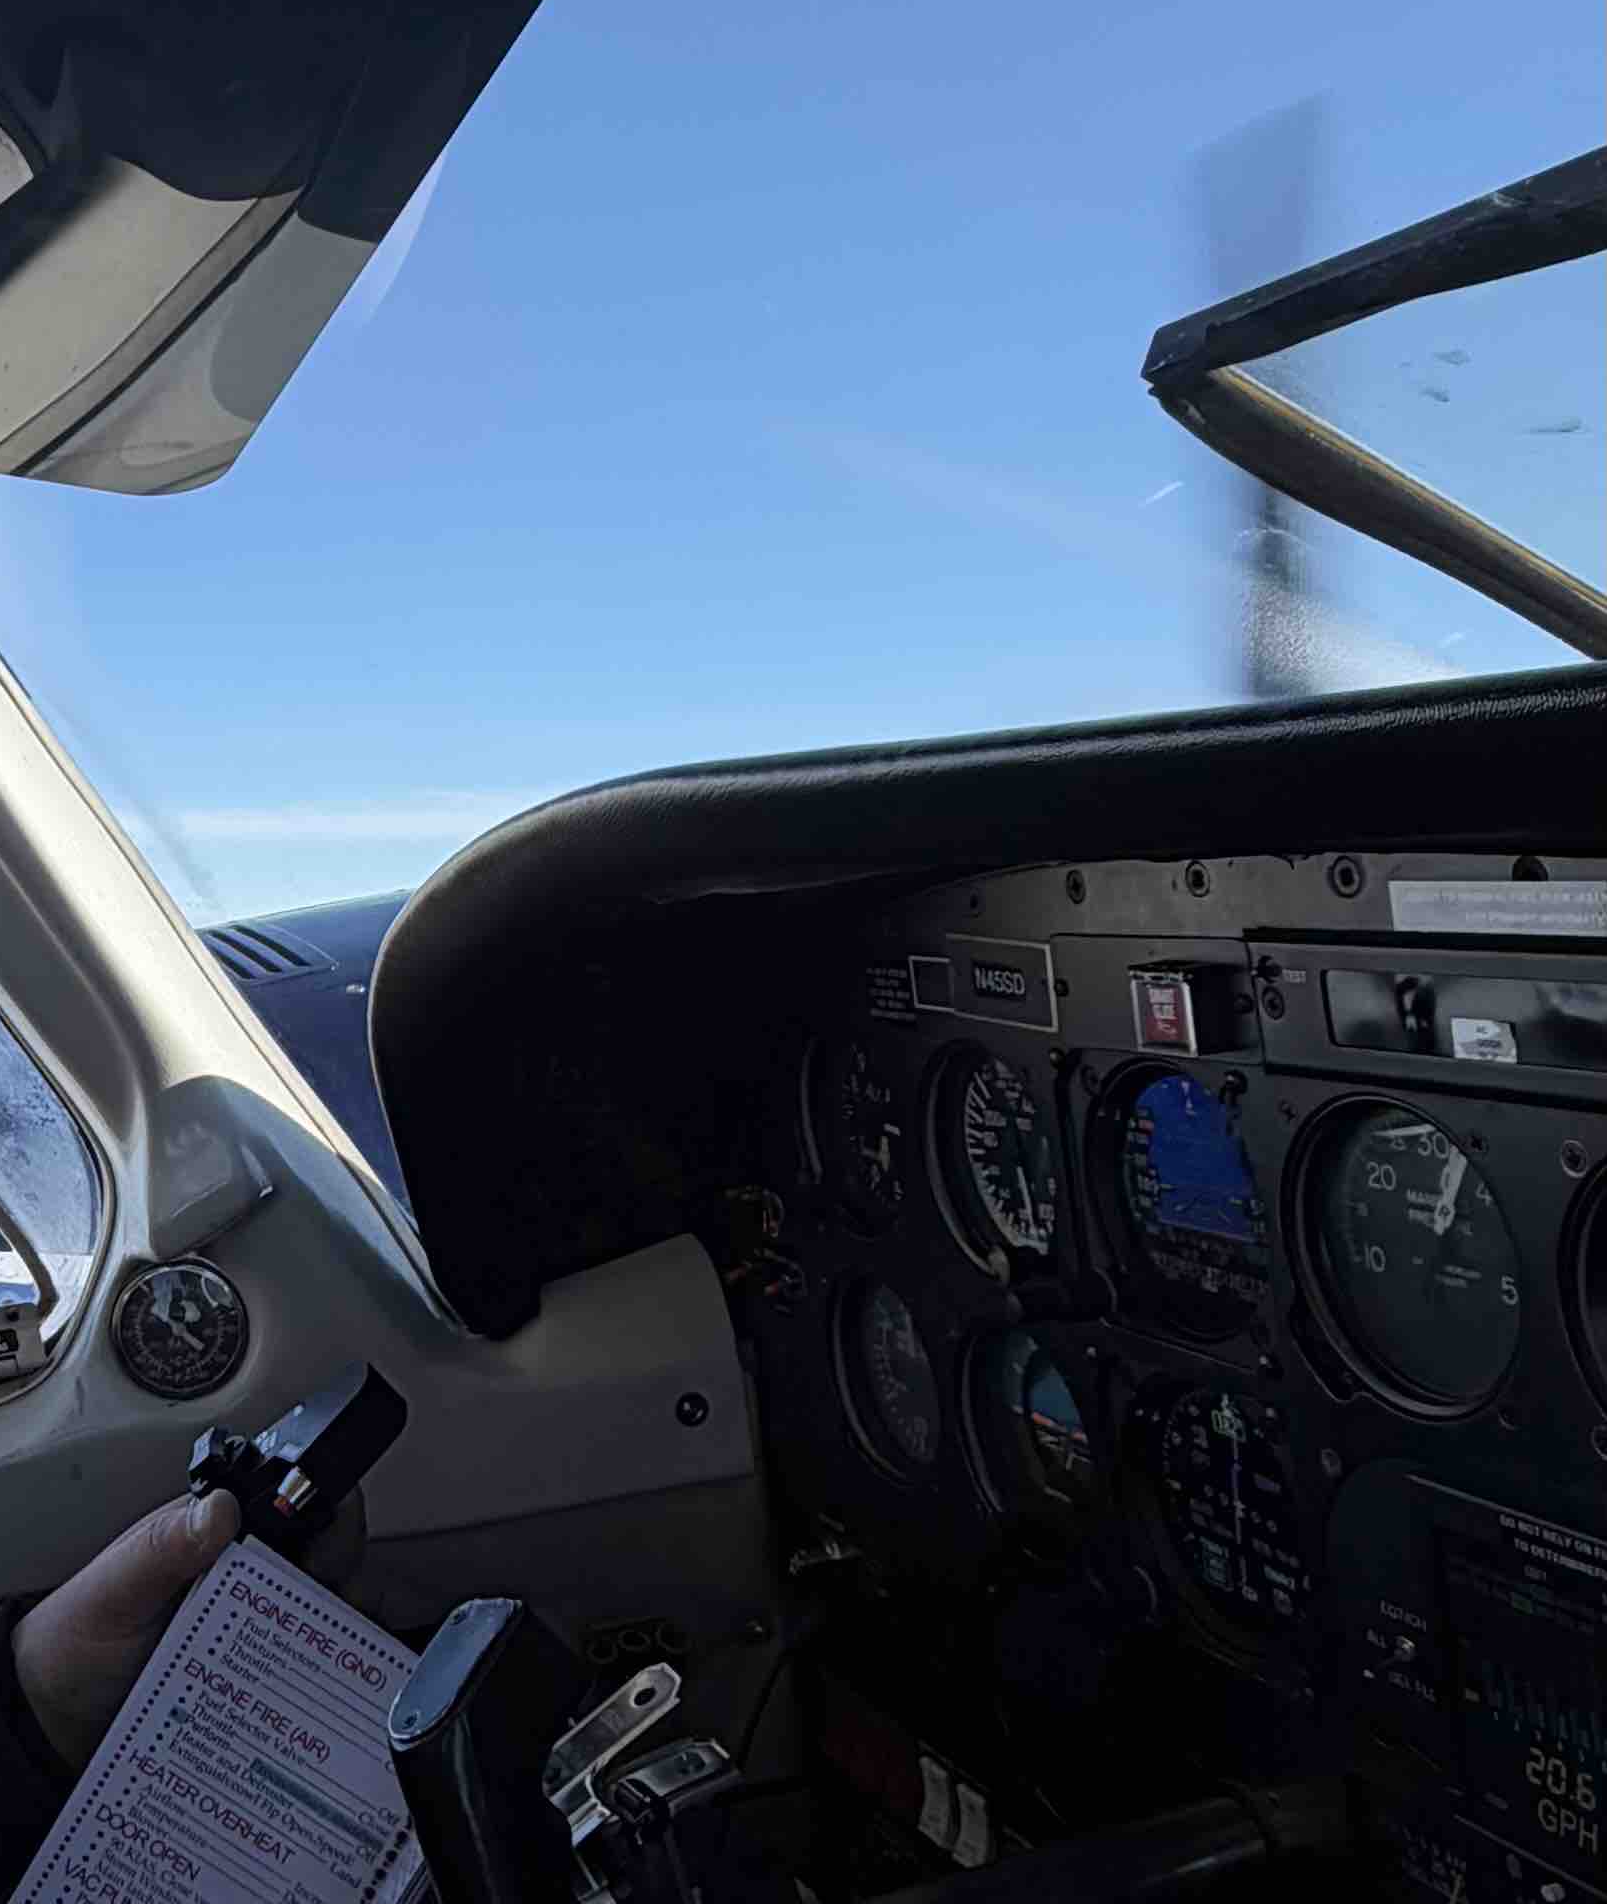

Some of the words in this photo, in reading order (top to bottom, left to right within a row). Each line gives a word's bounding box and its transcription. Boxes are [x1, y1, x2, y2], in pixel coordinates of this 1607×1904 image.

[1417, 1132, 1450, 1159] 30
[1367, 1162, 1396, 1191] 20
[1475, 1181, 1493, 1207] 4
[1362, 1244, 1386, 1273] 10
[1500, 1273, 1520, 1307] 5
[228, 1579, 298, 1633] ENGINE
[294, 1621, 338, 1659] FIRE
[333, 1648, 387, 1693] (GND)
[234, 1628, 287, 1669] Mixtures
[242, 1615, 271, 1640] Fuel
[269, 1632, 321, 1673] Selectors
[219, 1653, 260, 1684] Starter
[228, 1639, 274, 1677] Throttle
[182, 1656, 253, 1710] ENGINE
[248, 1698, 293, 1736] FIRE
[288, 1725, 331, 1764] (AIR)
[191, 1701, 237, 1738] Throttle
[197, 1689, 227, 1714] Fuel
[224, 1706, 271, 1744] Selector
[272, 1736, 306, 1765] Valve
[182, 1713, 231, 1751] Perform
[127, 1748, 200, 1805] HEATER
[198, 1794, 295, 1864] OVERHEAT
[141, 1782, 187, 1817] Airflow
[174, 1725, 216, 1758] Heater
[215, 1755, 241, 1774] and
[239, 1767, 294, 1809] Defroster
[354, 1843, 377, 1865] Off
[127, 1804, 169, 1838] Blower
[136, 1792, 208, 1848] Temperature
[1537, 1797, 1599, 1857] GPH
[94, 1802, 150, 1849] DOOR
[148, 1838, 201, 1881] OPEN
[63, 1856, 101, 1892] VAC
[328, 1860, 362, 1889] Land
